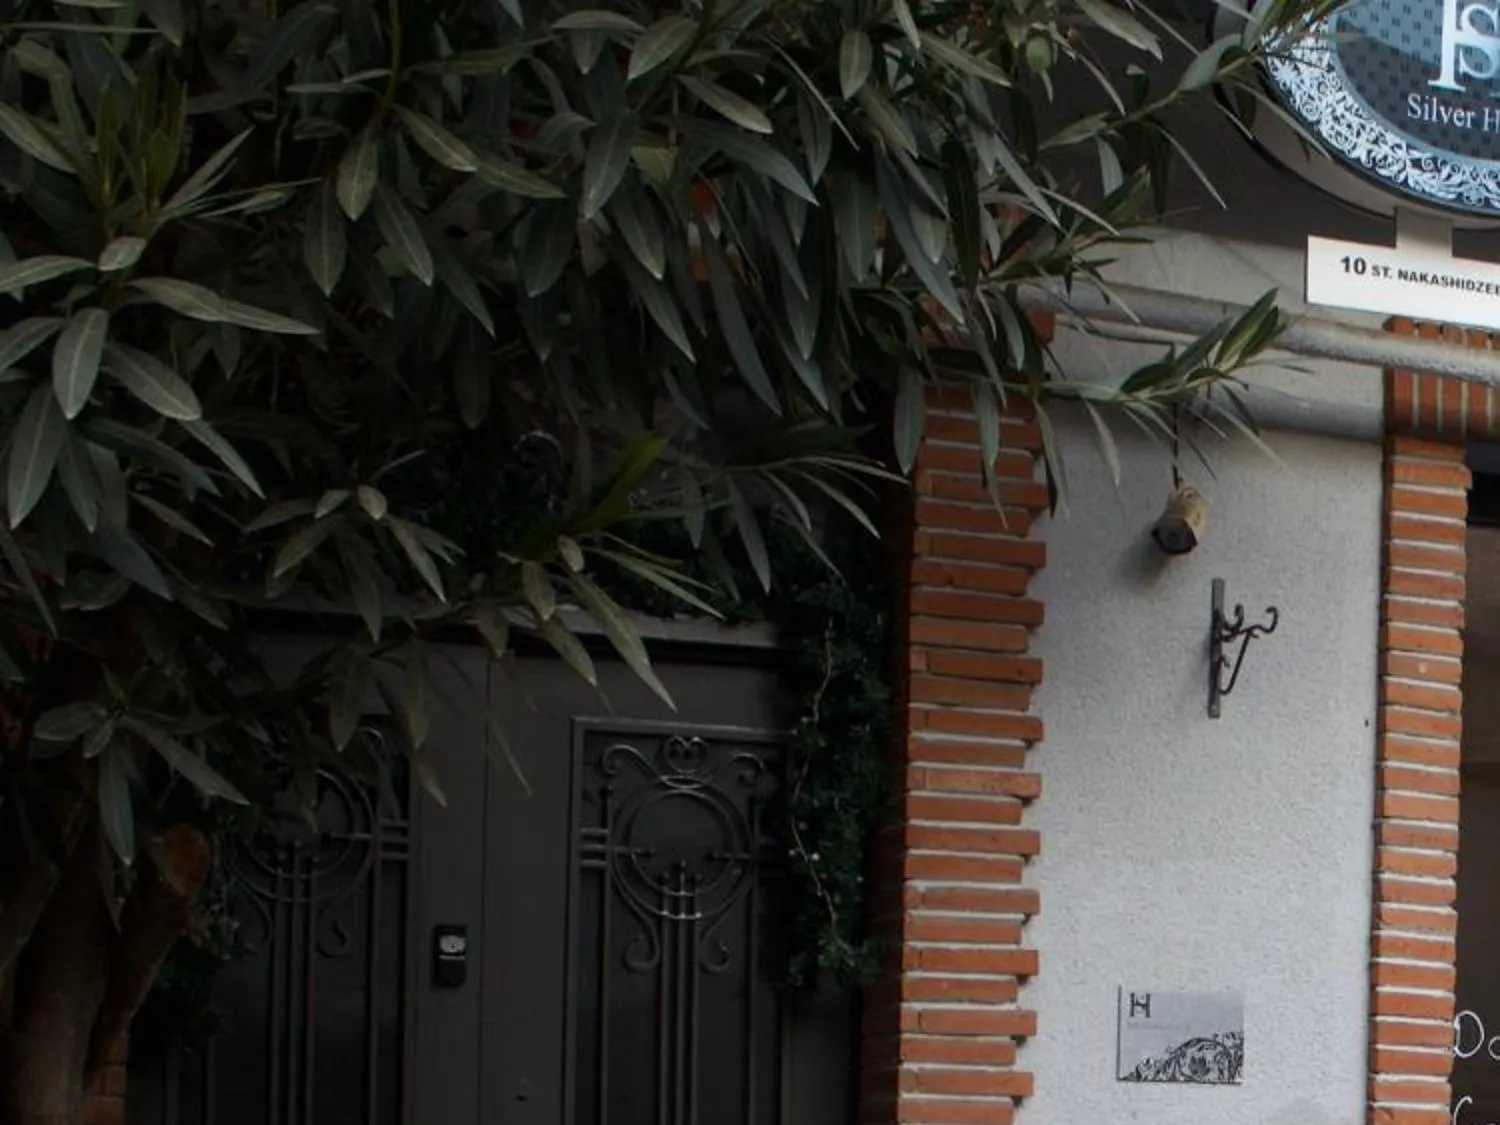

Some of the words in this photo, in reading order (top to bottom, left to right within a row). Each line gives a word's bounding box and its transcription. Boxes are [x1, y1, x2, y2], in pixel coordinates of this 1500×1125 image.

[1407, 93, 1476, 128] Silver
[1341, 255, 1367, 275] 10
[1371, 264, 1393, 279] ST.
